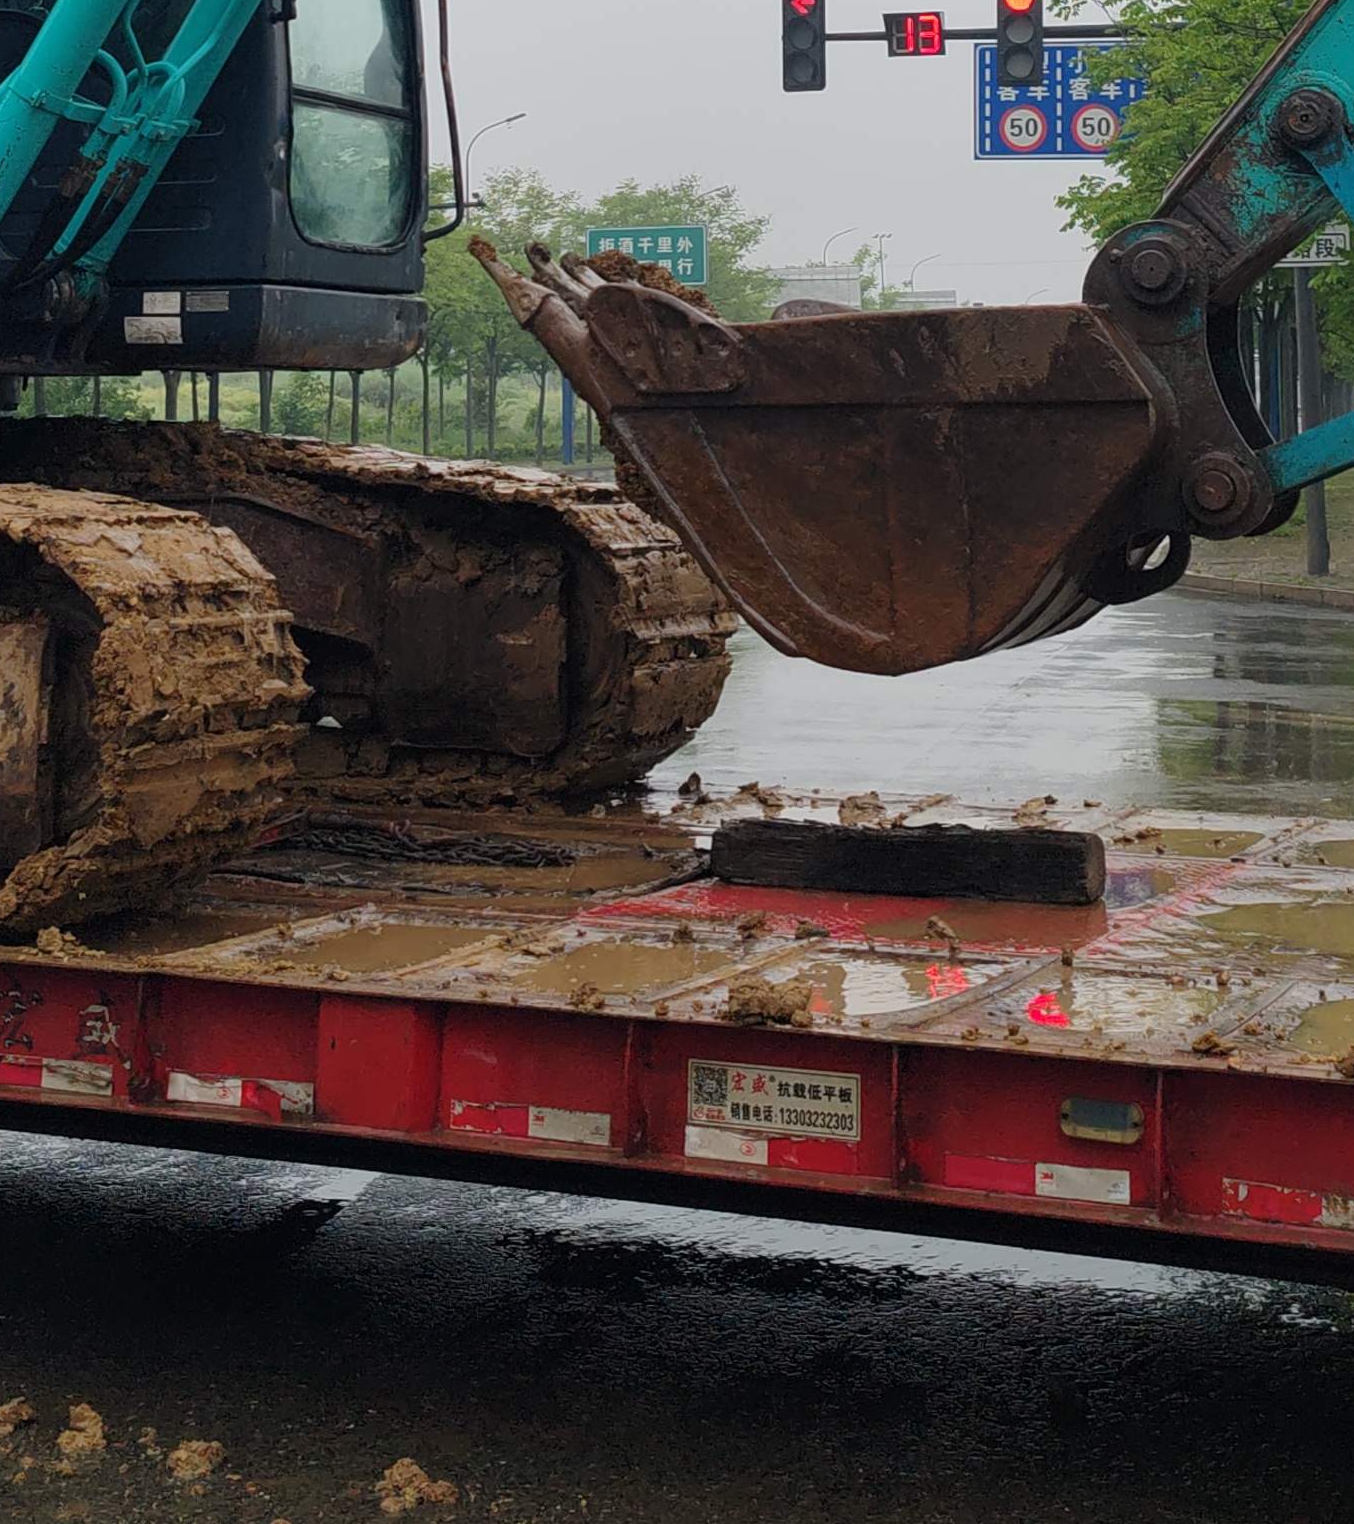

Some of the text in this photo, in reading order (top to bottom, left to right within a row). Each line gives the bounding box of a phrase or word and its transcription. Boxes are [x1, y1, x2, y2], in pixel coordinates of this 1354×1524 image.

[906, 14, 941, 54] 13
[1009, 117, 1039, 137] 50
[1081, 116, 1111, 137] 50
[598, 237, 693, 254] 拒酒千里外
